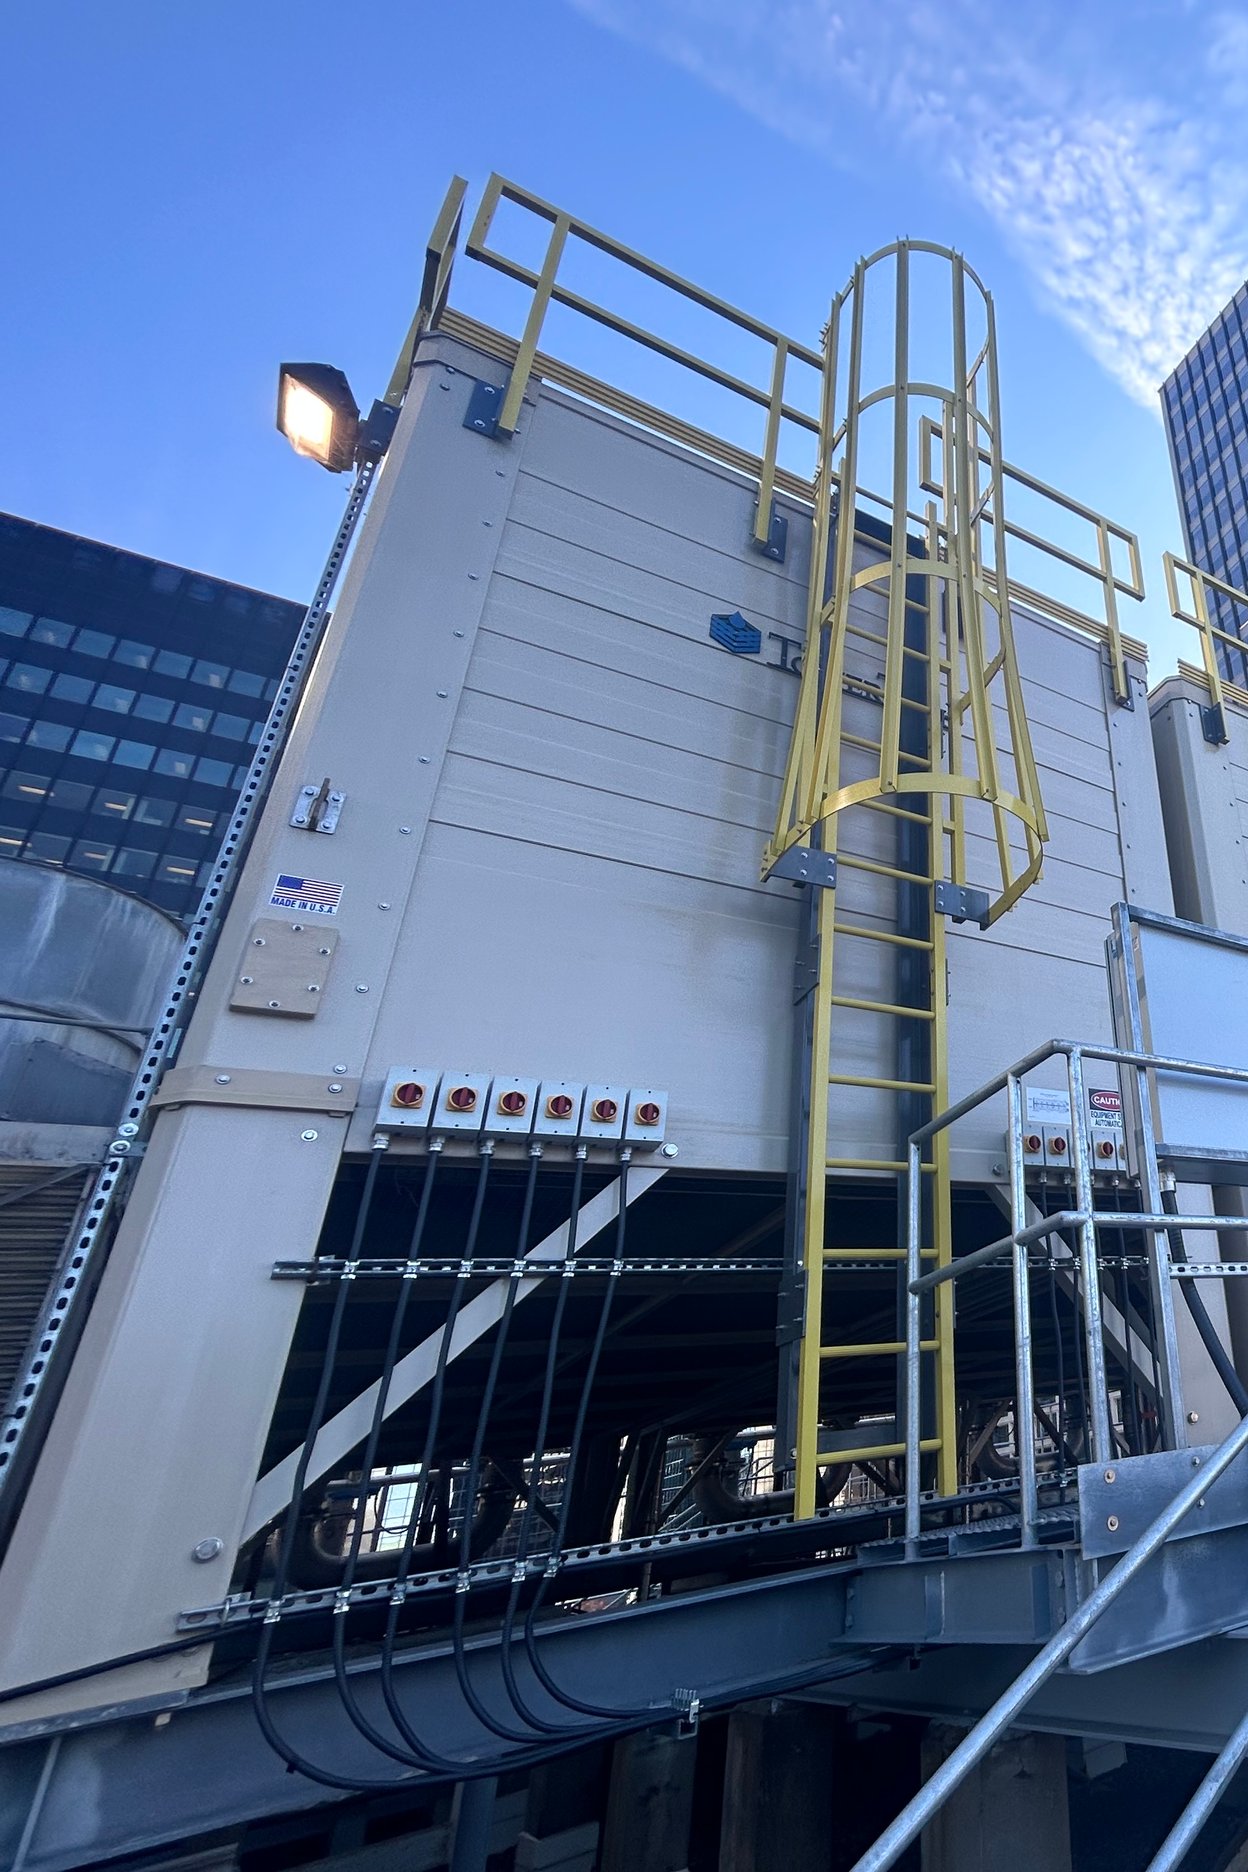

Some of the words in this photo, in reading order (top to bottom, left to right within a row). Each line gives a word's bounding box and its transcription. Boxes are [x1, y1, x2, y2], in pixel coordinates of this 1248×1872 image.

[270, 896, 297, 908] MADE
[298, 901, 307, 910] IN
[309, 902, 336, 914] U.S.A.
[1093, 1095, 1120, 1106] CAUTI
[1090, 1110, 1116, 1119] EQUIPMENT
[1094, 1118, 1122, 1128] AUTOMATIC
